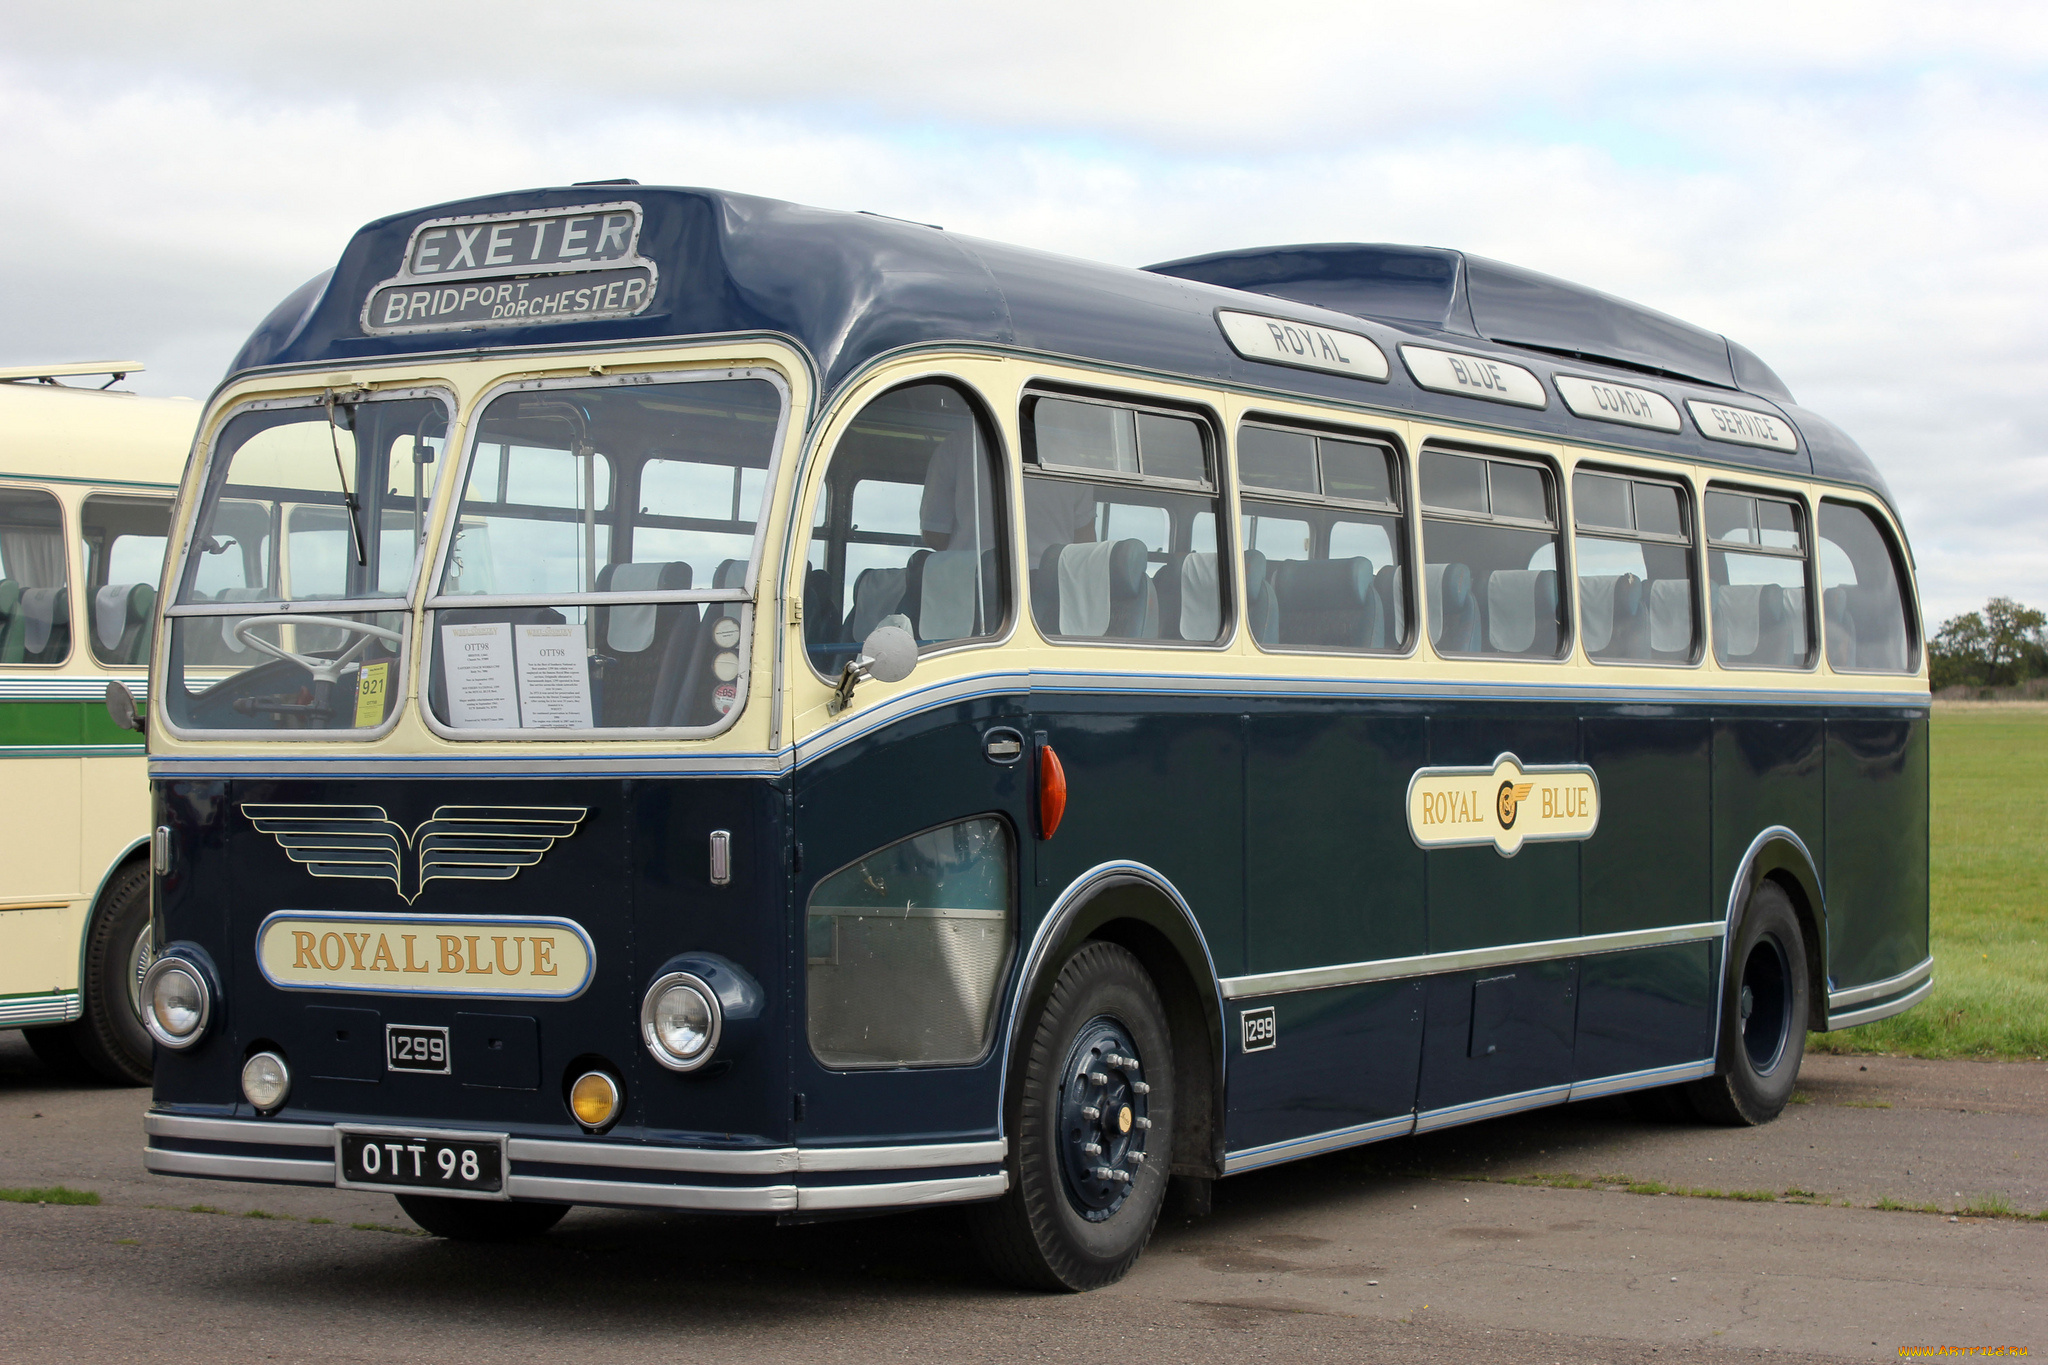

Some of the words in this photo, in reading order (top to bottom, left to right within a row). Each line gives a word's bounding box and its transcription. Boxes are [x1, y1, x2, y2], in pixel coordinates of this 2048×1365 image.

[412, 214, 633, 274] EXETER
[383, 283, 529, 324] BRIDPORT
[491, 277, 647, 319] DORCHESTER
[1266, 322, 1350, 364] ROYAL
[1447, 356, 1507, 392] BLUE
[1591, 385, 1653, 419] COACH
[1711, 407, 1779, 442] SERVICE
[464, 642, 490, 652] OTT98
[539, 648, 566, 657] OTT98
[362, 678, 384, 695] 921
[1422, 790, 1484, 825] ROYAL
[1541, 787, 1589, 819] BLUE
[291, 931, 429, 973] ROYAL
[436, 935, 558, 977] BLUE
[391, 1035, 445, 1062] 1299
[1245, 1017, 1273, 1042] 1299
[362, 1143, 426, 1177] OTT
[437, 1148, 480, 1182] 98
